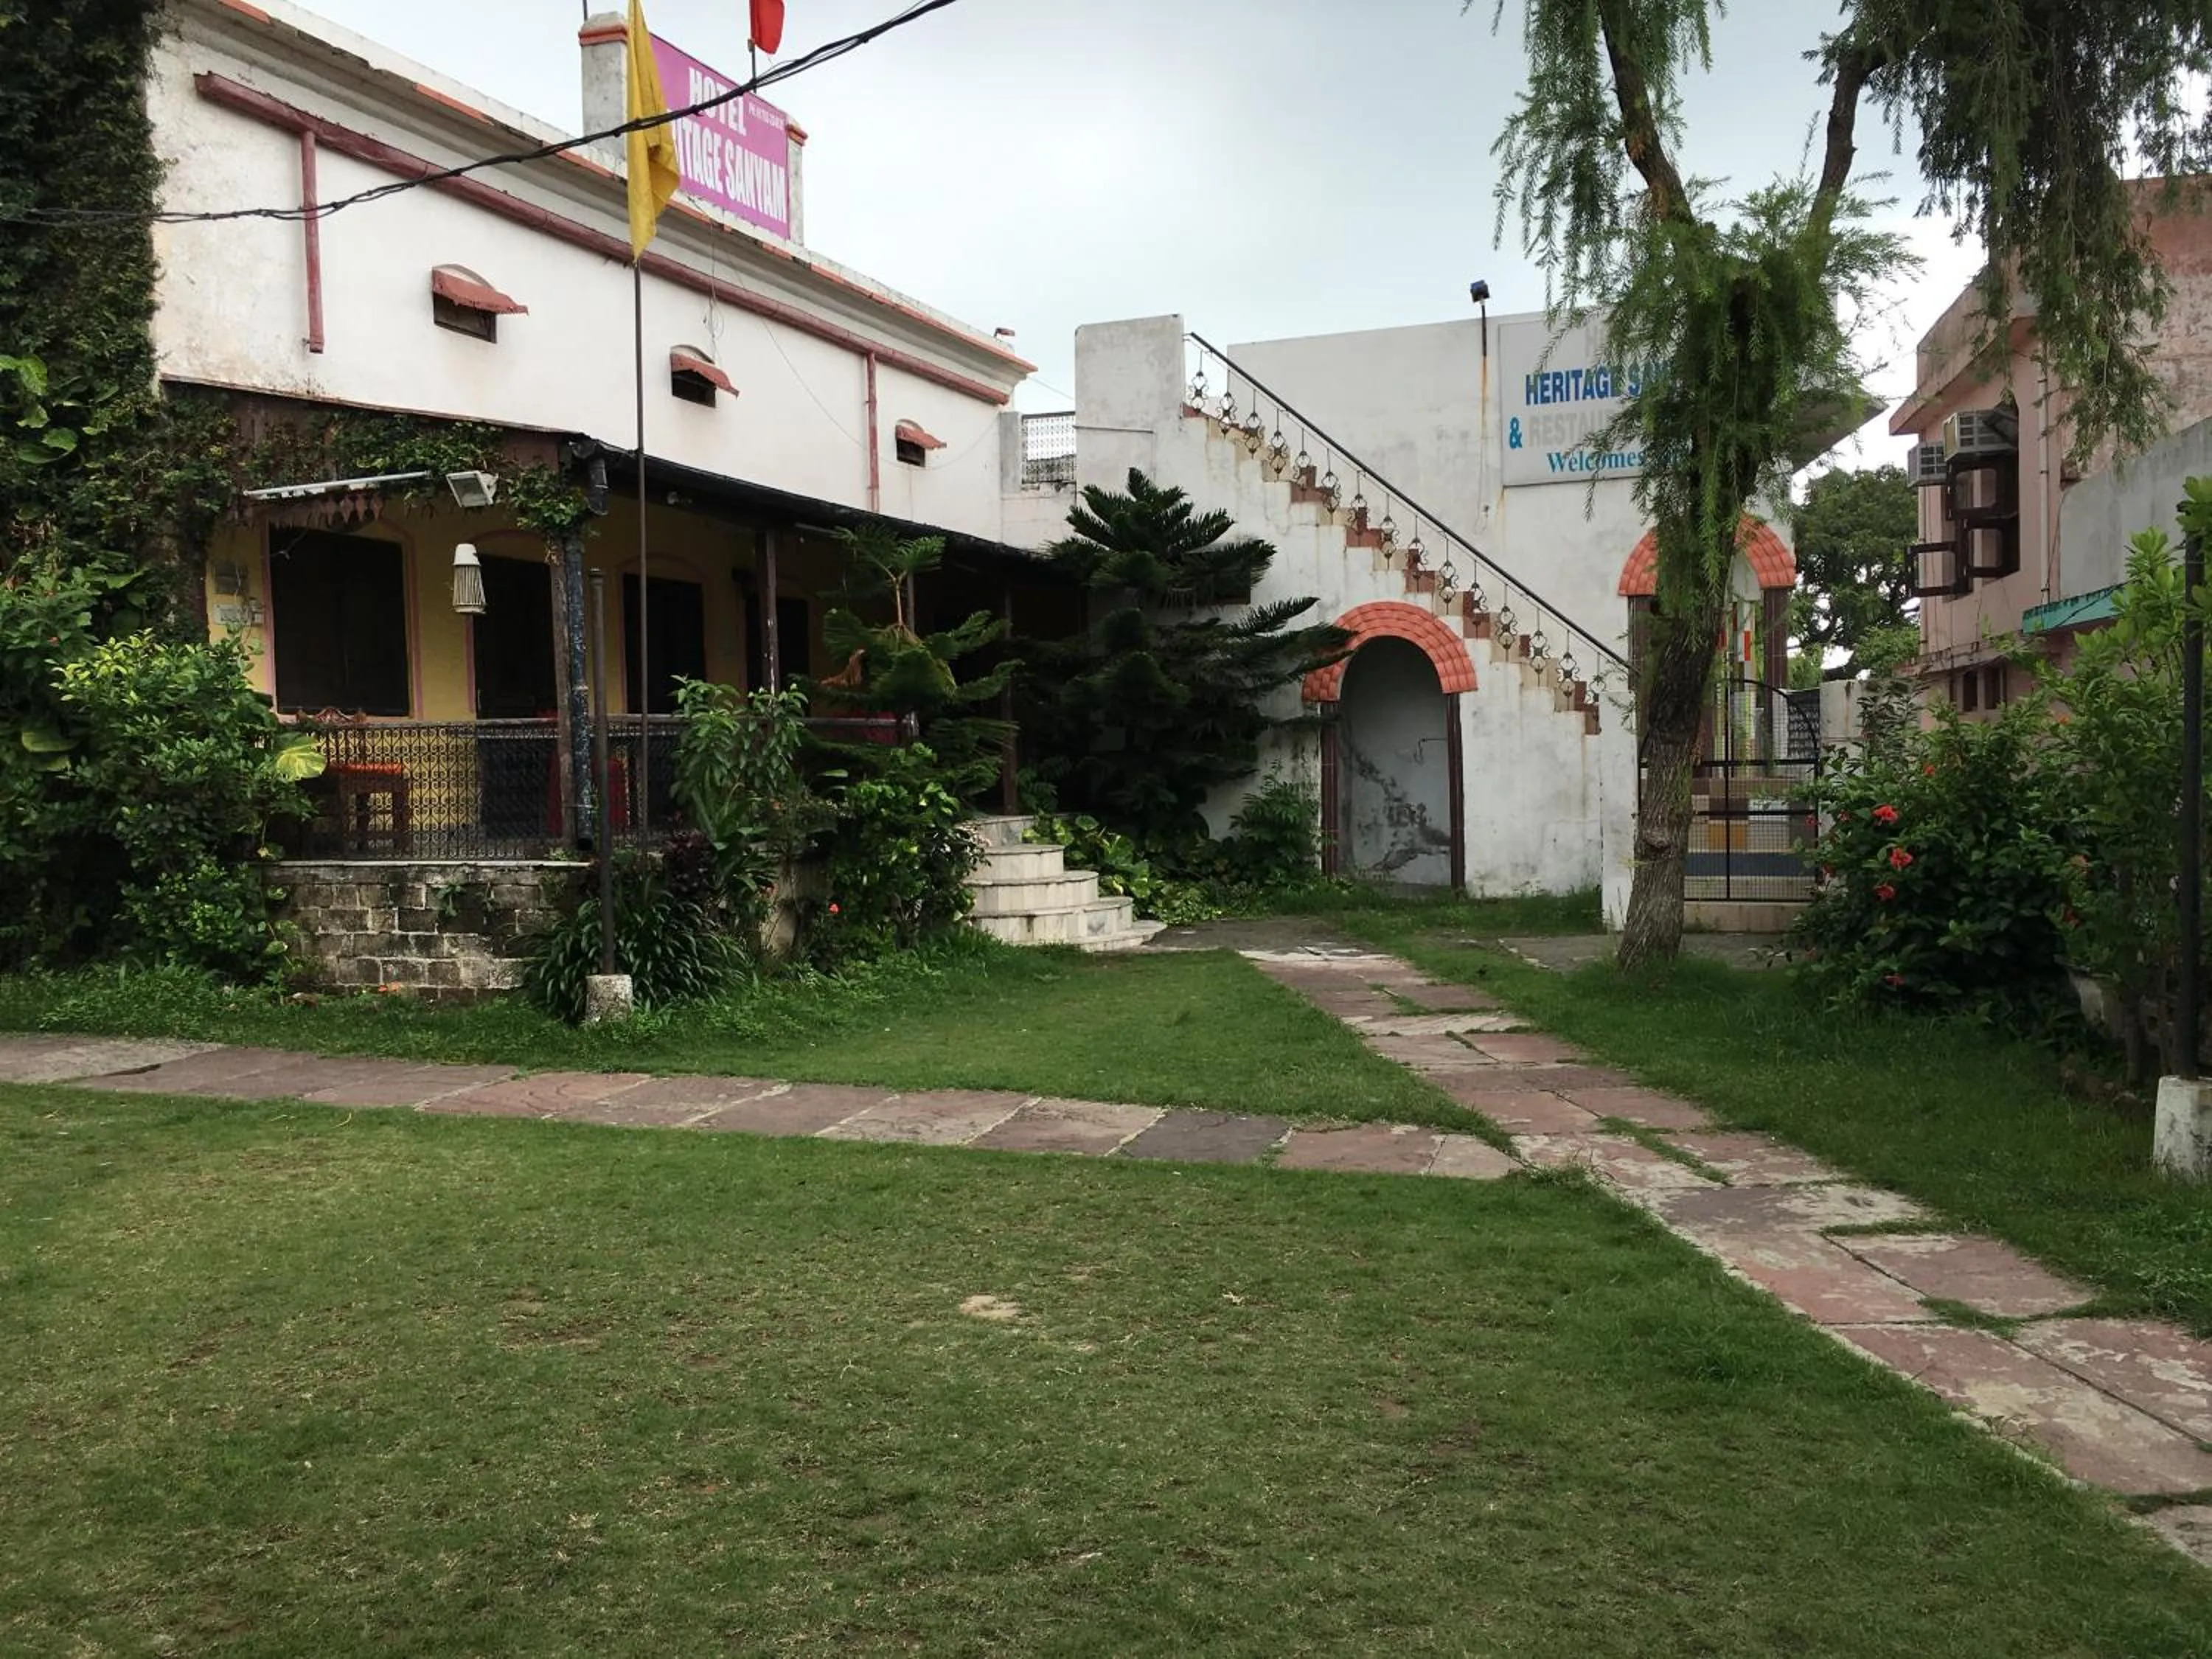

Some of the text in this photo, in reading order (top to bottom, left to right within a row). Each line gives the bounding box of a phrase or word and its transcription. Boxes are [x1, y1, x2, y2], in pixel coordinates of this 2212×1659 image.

[689, 66, 747, 136] HOTEL
[669, 110, 787, 223] ITAGE SANYAM
[1509, 417, 1523, 449] &
[1546, 450, 1645, 473] Welcomes
